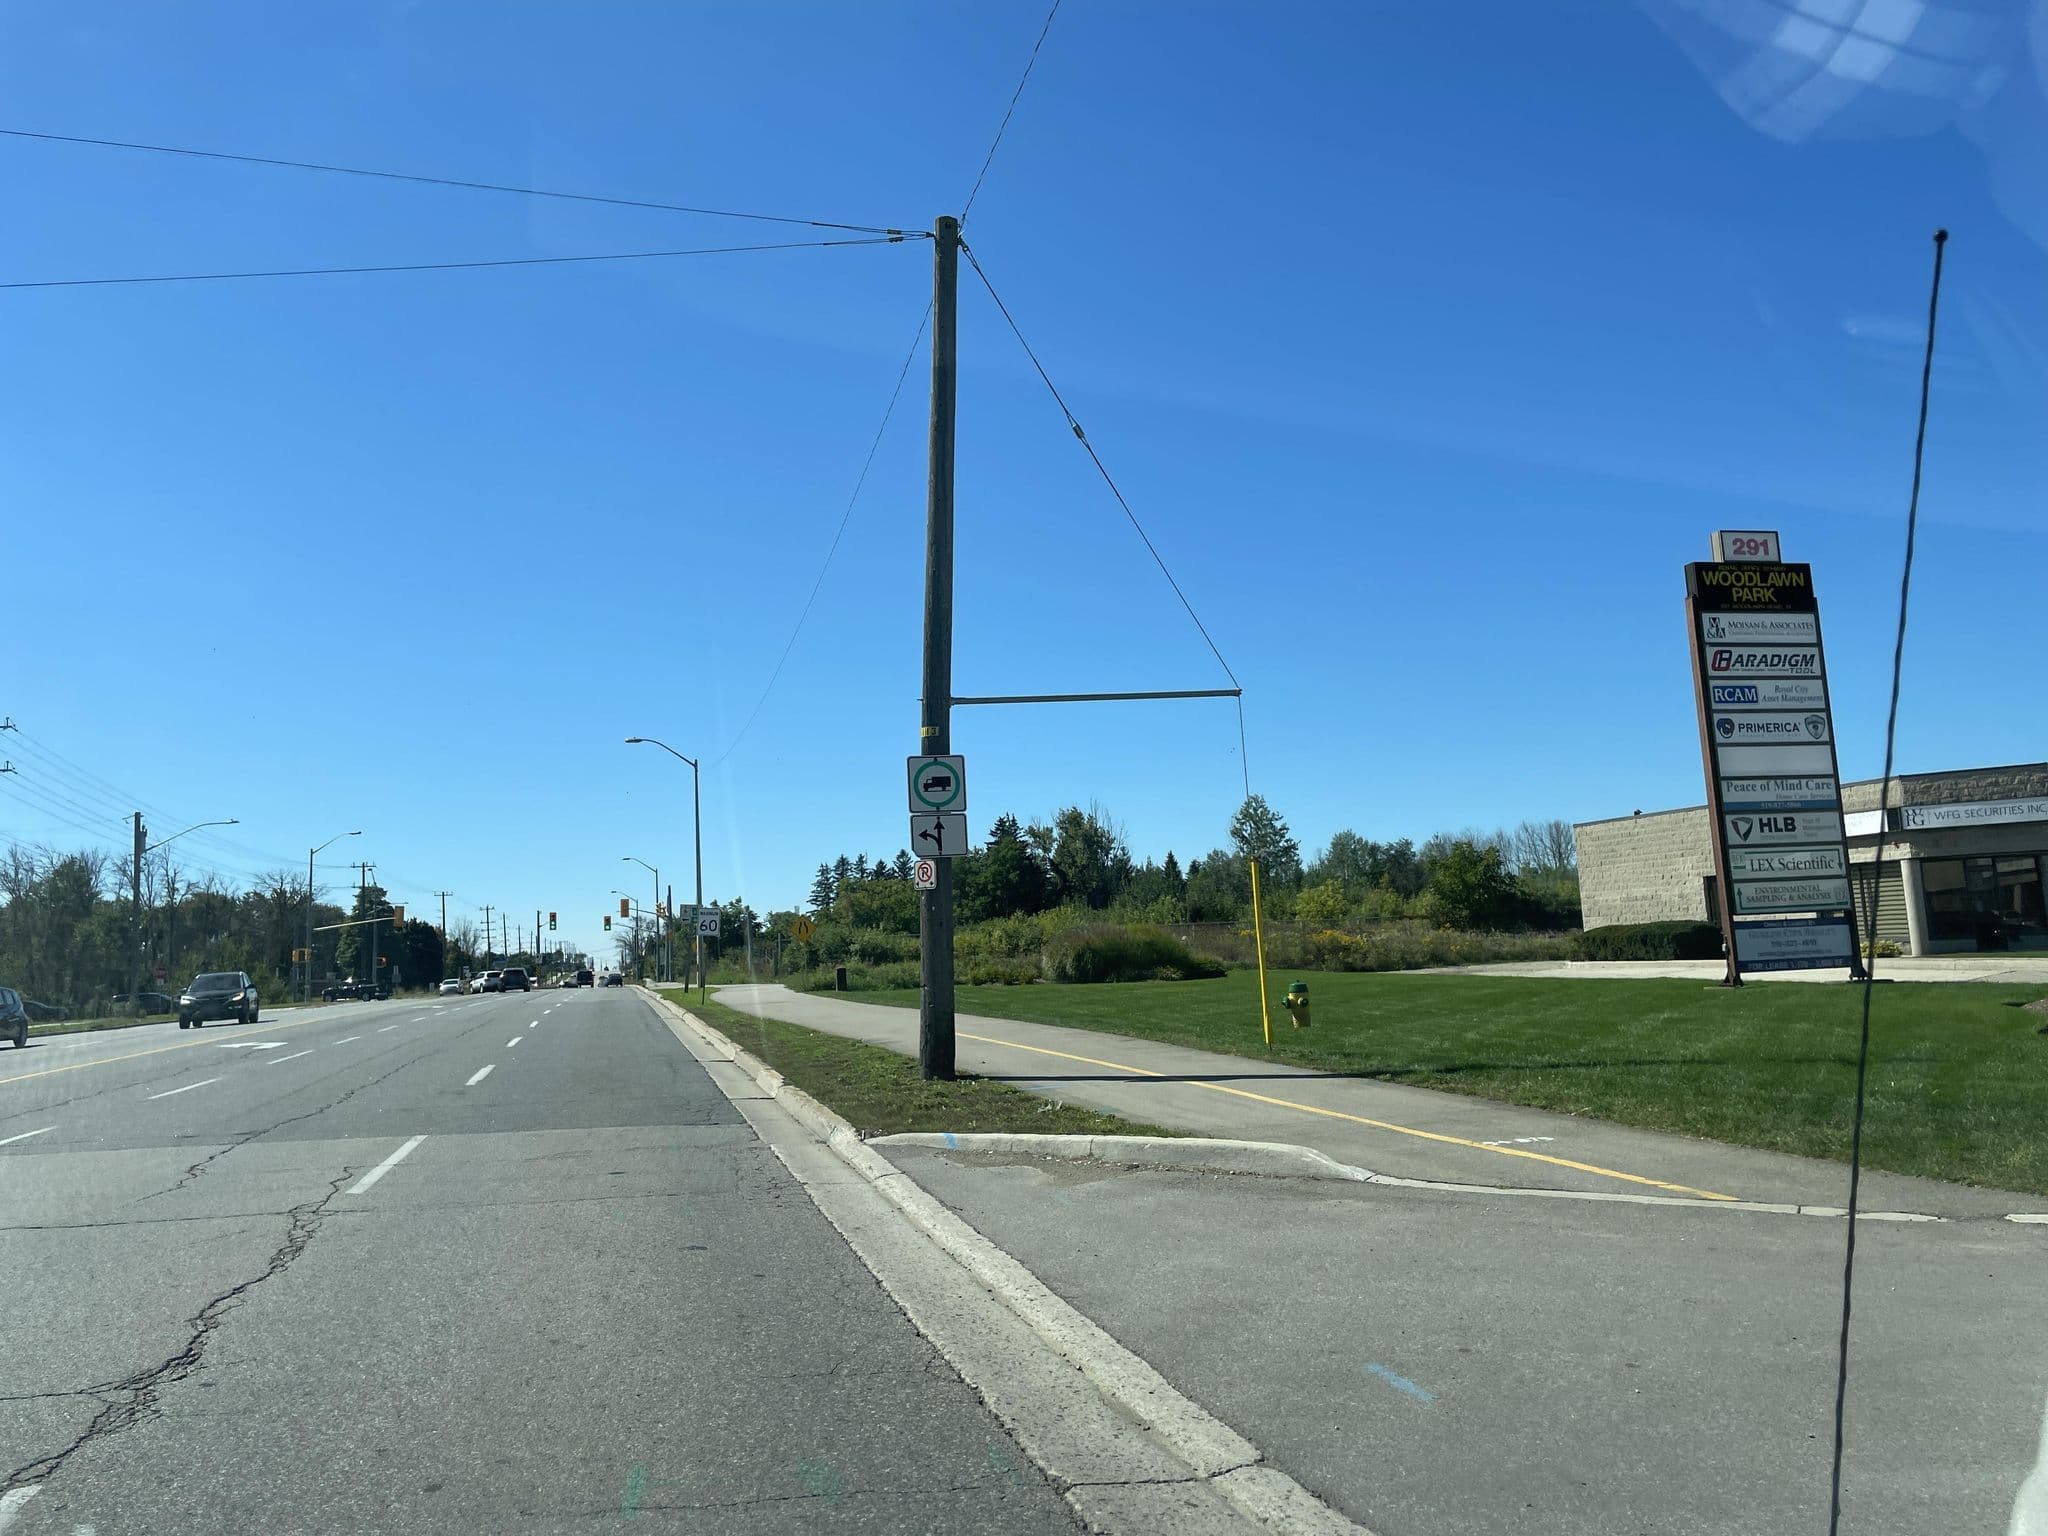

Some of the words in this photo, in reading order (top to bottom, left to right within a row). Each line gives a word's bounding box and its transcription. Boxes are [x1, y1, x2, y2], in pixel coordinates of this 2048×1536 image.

[1732, 538, 1769, 555] 291
[1702, 570, 1805, 586] WOODLAWN
[1732, 587, 1777, 602] PARK
[1761, 621, 1768, 629] &
[1769, 621, 1814, 630] ASSOCIATES
[1714, 688, 1757, 702] RCAM
[1774, 685, 1793, 694] Royal
[1762, 694, 1779, 702] Asset
[1782, 694, 1823, 703] Management
[1738, 722, 1798, 733] PRIMERICA
[1726, 782, 1757, 792] Peace
[1760, 780, 1771, 791] of
[1774, 780, 1802, 791] Mind
[1806, 779, 1832, 790] Care
[1934, 810, 1960, 820] WFG
[1964, 805, 2024, 818] SECURITIES
[1758, 816, 1797, 833] HLB
[1750, 858, 1775, 872] LEX
[1778, 855, 1835, 871] Scientific
[1754, 884, 1820, 895] ENVIRONMENTAL
[1746, 894, 1787, 904] SAMPLING
[1794, 892, 1831, 901] ANALYSIS
[700, 919, 718, 932] 60
